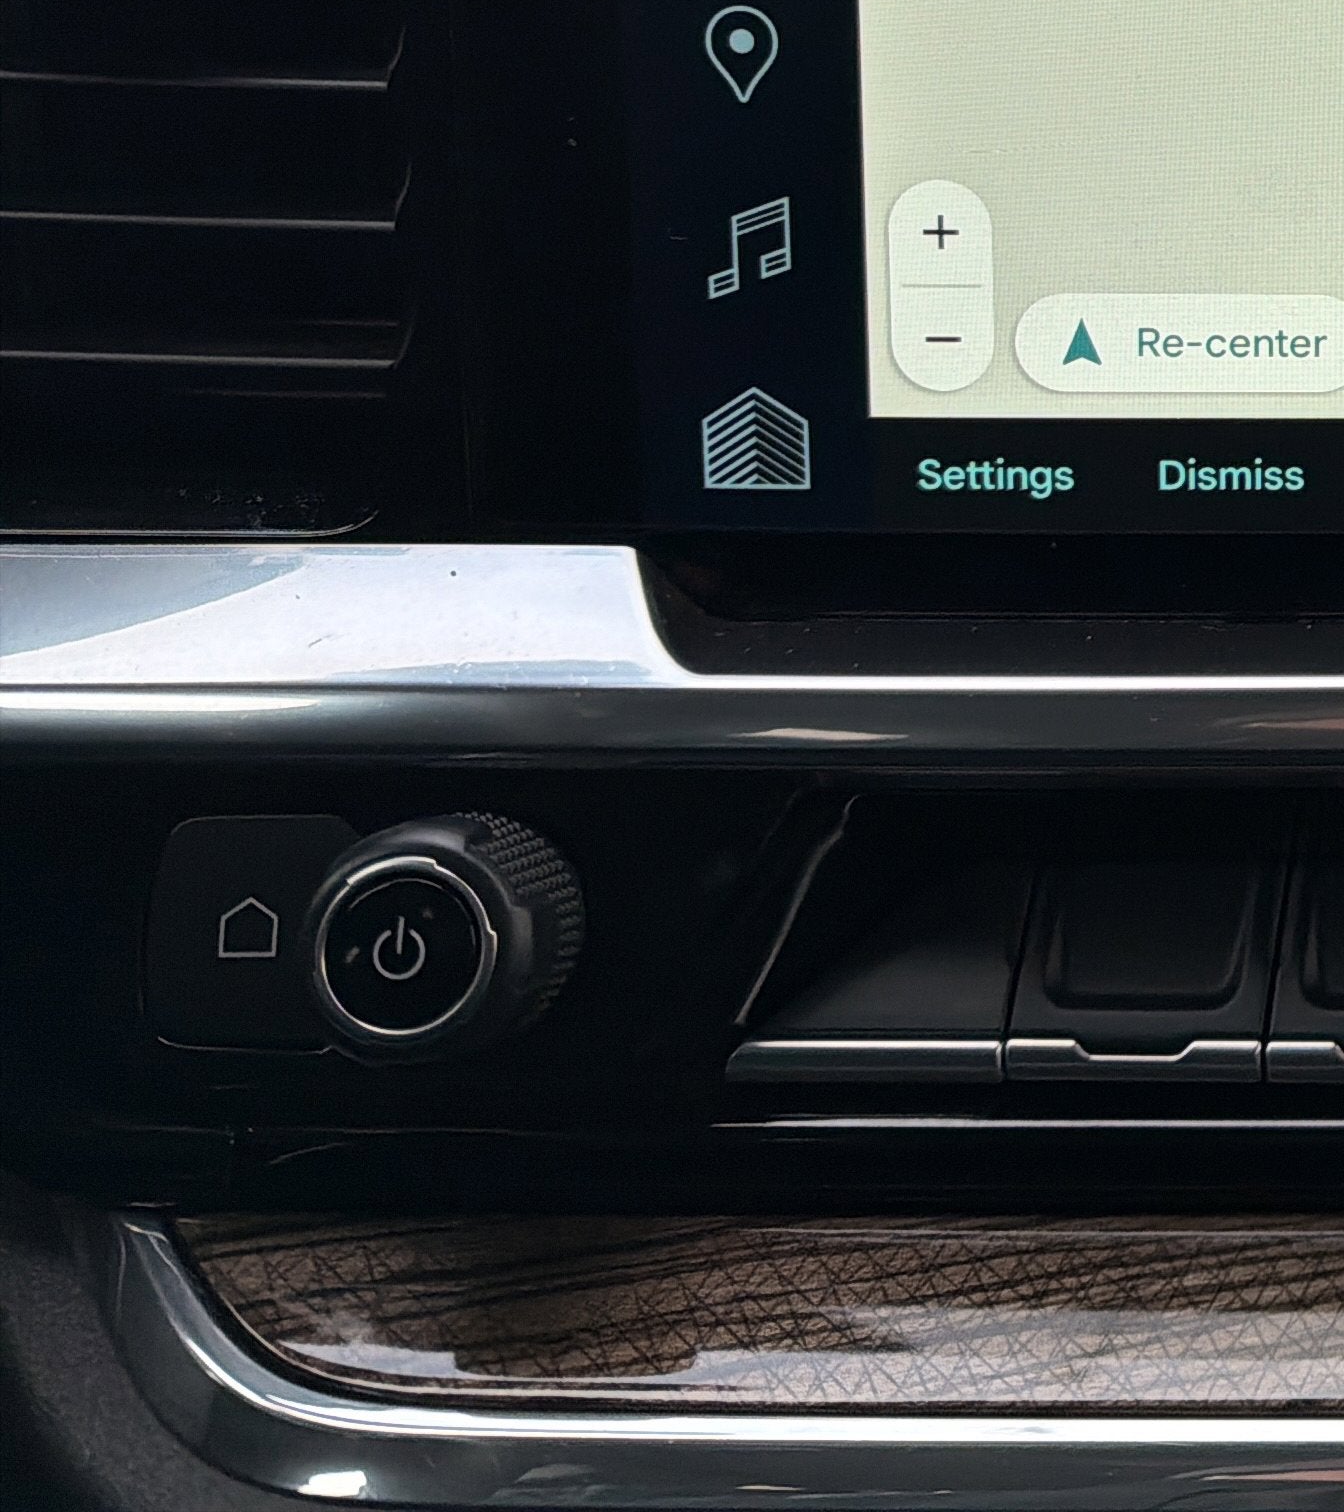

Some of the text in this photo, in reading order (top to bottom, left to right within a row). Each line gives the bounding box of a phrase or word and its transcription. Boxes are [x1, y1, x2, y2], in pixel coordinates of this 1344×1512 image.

[1136, 326, 1328, 358] Re-center
[917, 457, 1075, 500] Settings
[1158, 457, 1305, 491] Dismiss
